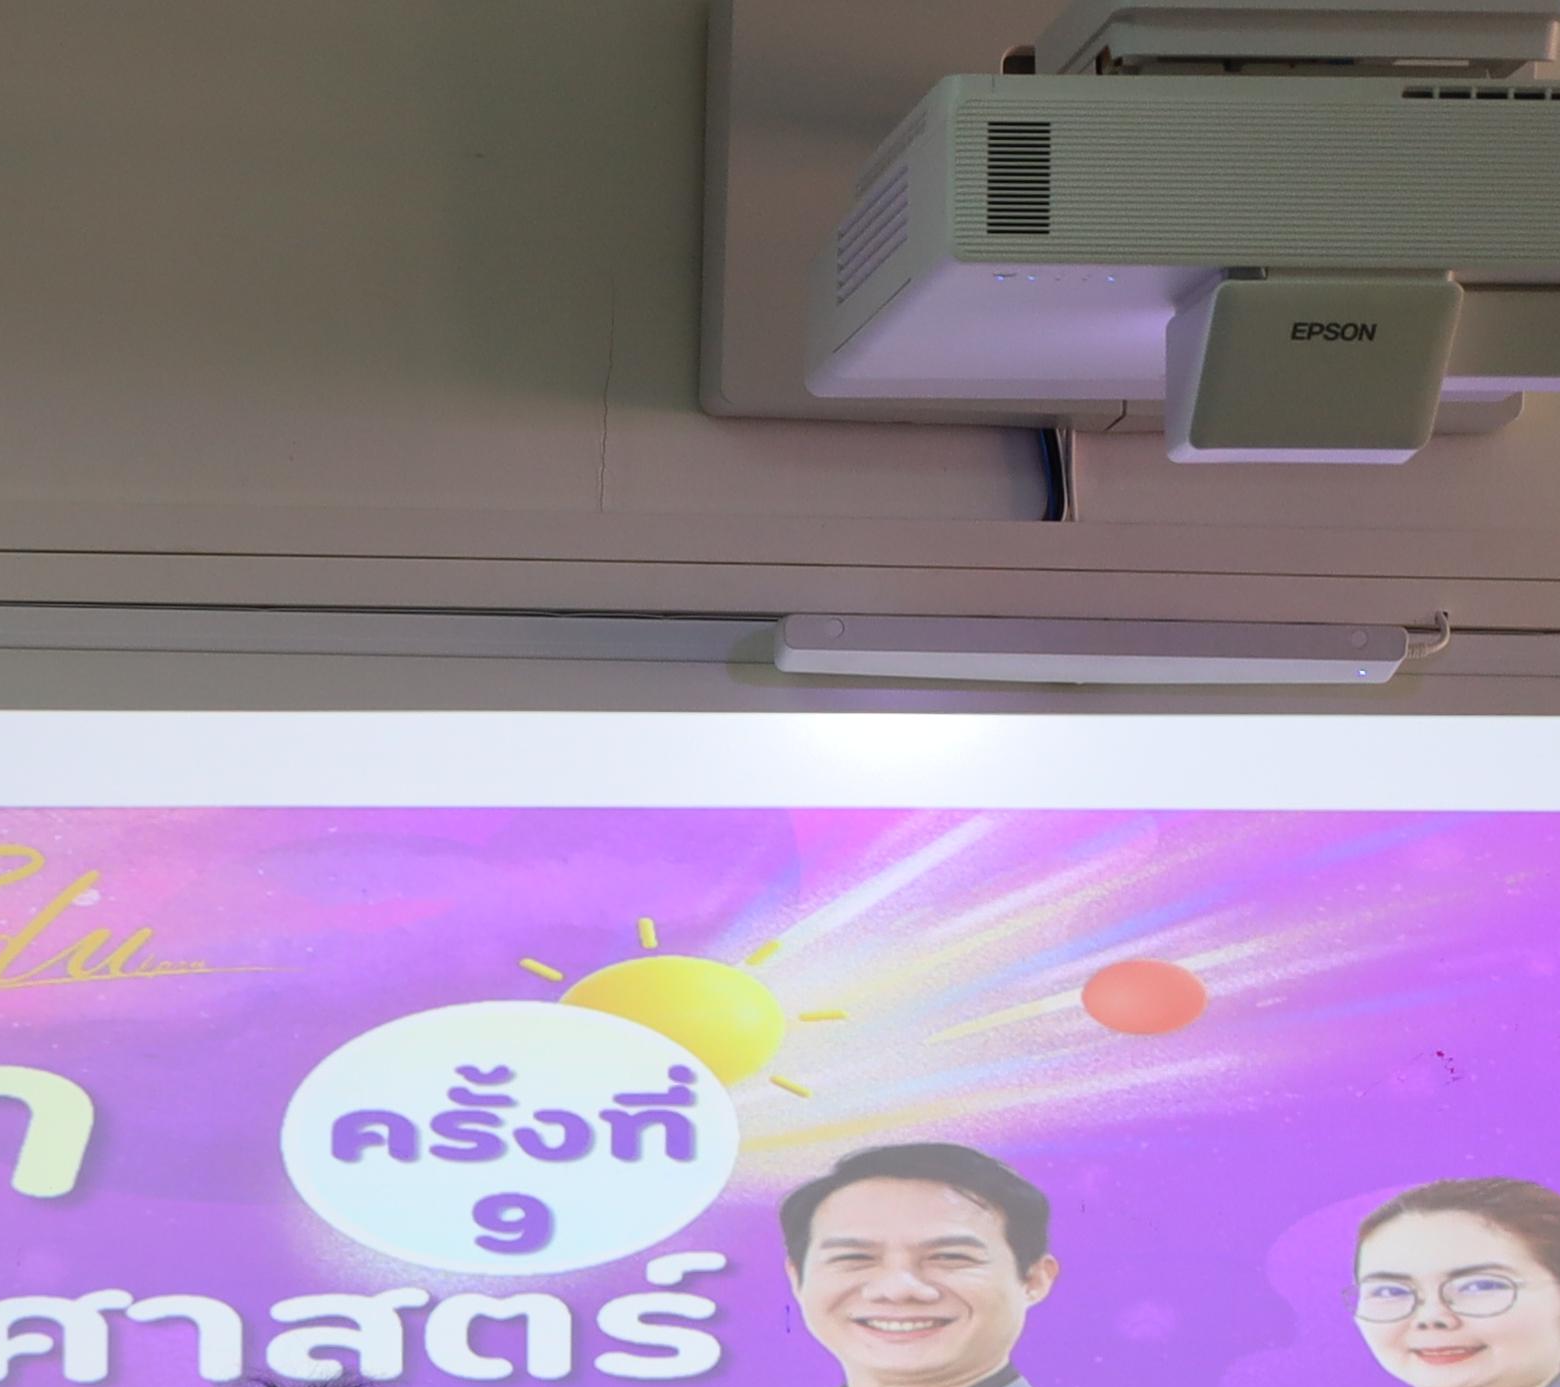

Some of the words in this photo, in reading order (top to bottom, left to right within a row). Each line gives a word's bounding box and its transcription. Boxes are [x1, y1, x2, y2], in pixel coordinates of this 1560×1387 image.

[1290, 322, 1377, 341] EPSON
[331, 1065, 698, 1163] ครั้งที่
[472, 1193, 554, 1255] 9
